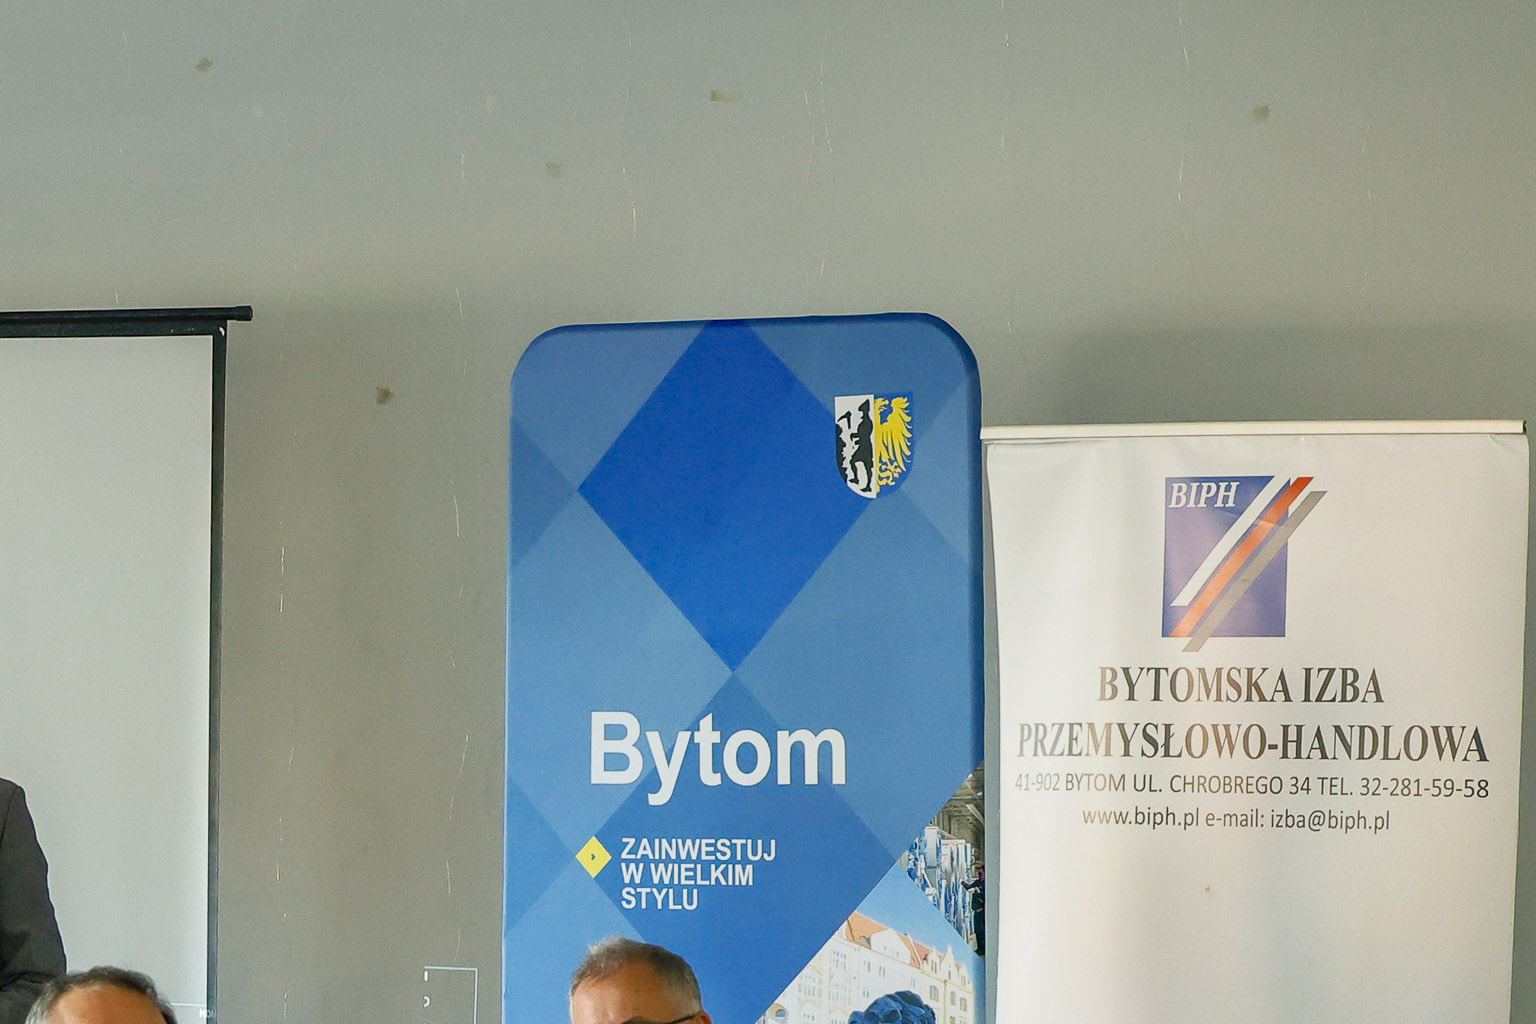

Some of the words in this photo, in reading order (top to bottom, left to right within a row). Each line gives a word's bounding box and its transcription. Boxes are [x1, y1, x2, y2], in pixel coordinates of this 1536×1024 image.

[1168, 481, 1240, 508] BIPH
[1098, 666, 1293, 703] BYTOMSKA
[1301, 667, 1385, 704] IZBA
[1016, 722, 1490, 763] PRZEMYSŁOWO-HANDLOWA
[590, 711, 846, 806] Bytom
[1015, 772, 1061, 792] 41-902
[1065, 772, 1126, 793] BYTOM
[1133, 773, 1163, 793] UL.
[1170, 774, 1284, 795] CHROBREGO
[1289, 776, 1312, 796] 34
[1317, 776, 1354, 796] TEL.
[1360, 777, 1490, 799] 32-281-59-58
[1082, 805, 1200, 831] www.biph.pl
[1205, 807, 1265, 828] e-mail:
[1270, 808, 1390, 835] izba@biph.pl
[620, 837, 776, 862] ZAINWESTUJ
[620, 862, 644, 885] W
[650, 862, 754, 887] WIELKIM
[620, 886, 699, 911] STYLU
